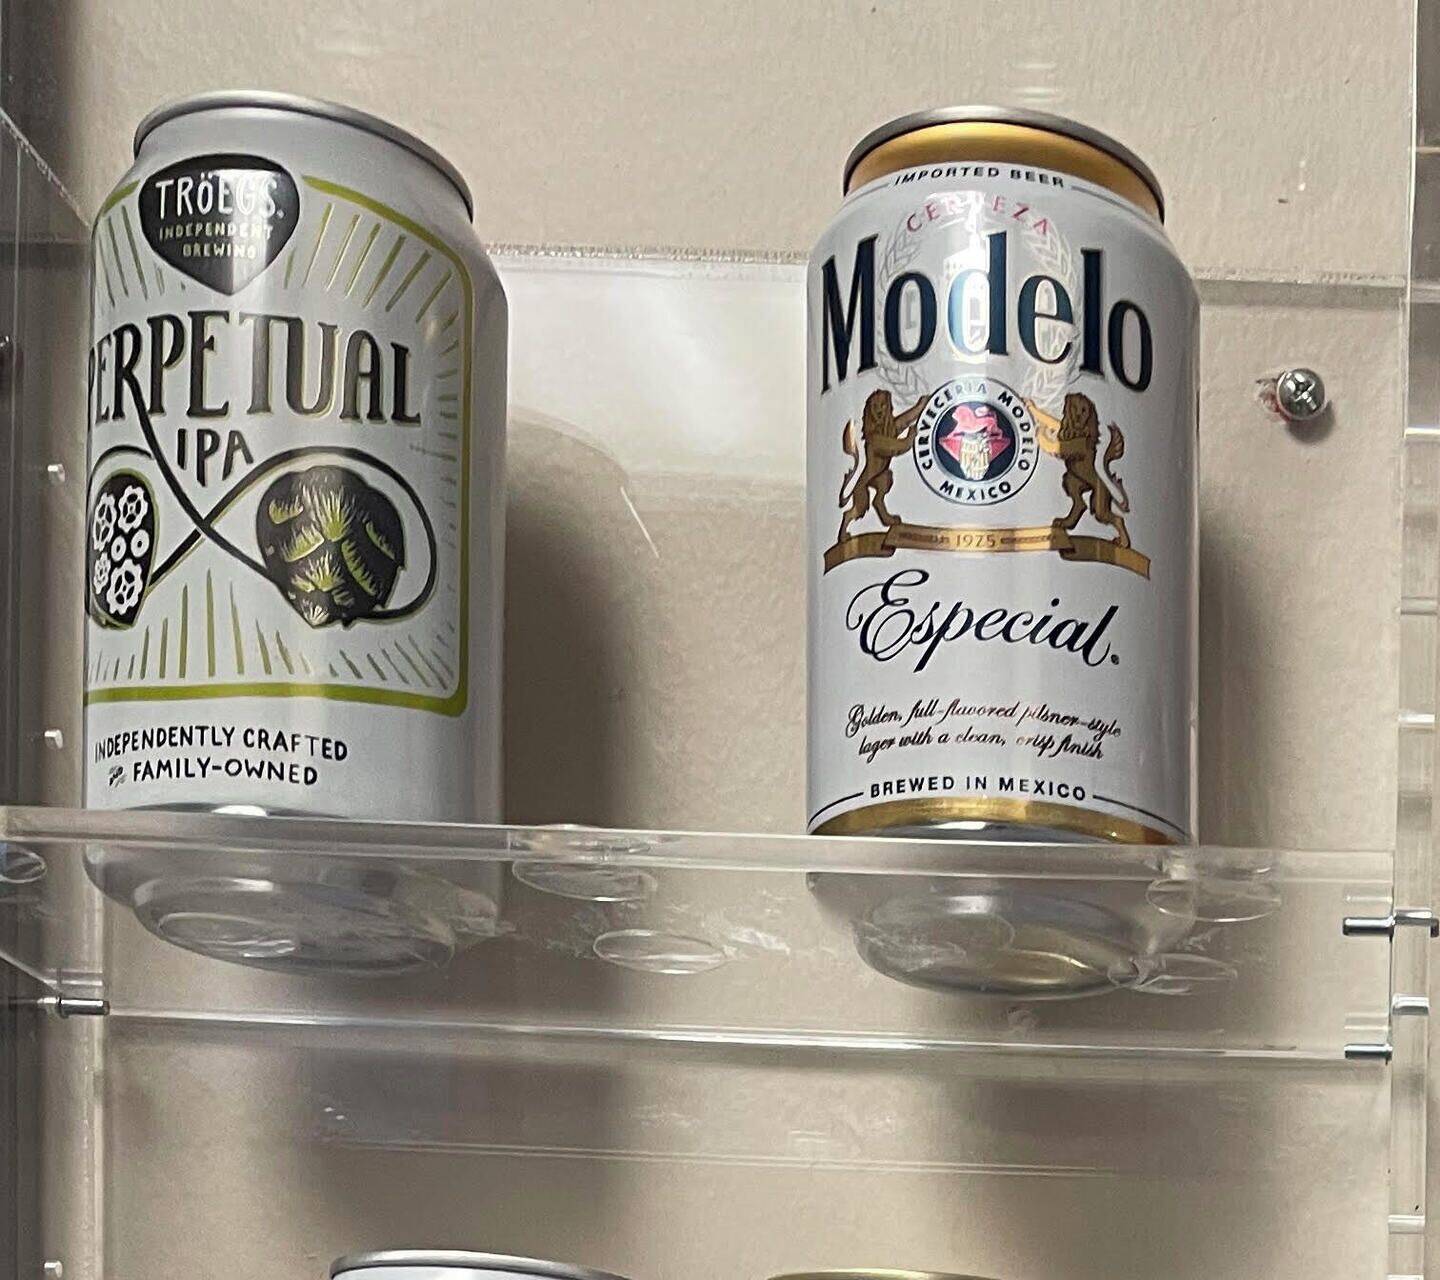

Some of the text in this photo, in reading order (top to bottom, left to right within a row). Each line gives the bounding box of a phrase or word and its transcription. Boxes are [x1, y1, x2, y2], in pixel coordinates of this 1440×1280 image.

[894, 166, 1065, 188] IMPORTED BEER
[182, 243, 256, 259] BREWING
[821, 231, 1153, 395] Modelo
[918, 383, 1034, 471] CERVECERIA MODELO
[177, 428, 254, 487] IPA
[939, 480, 1012, 501] MEXICO
[846, 569, 1119, 673] Especial
[94, 725, 349, 763] INDEPENDENTLY CRAFTED
[859, 735, 896, 764] lager
[898, 731, 934, 748] with
[937, 735, 950, 745] a
[1015, 733, 1055, 760] crisp
[1053, 734, 1104, 760] finish
[133, 757, 319, 786] FAMILY-OWNED
[870, 776, 1086, 801] BREWED IN MEXICO
